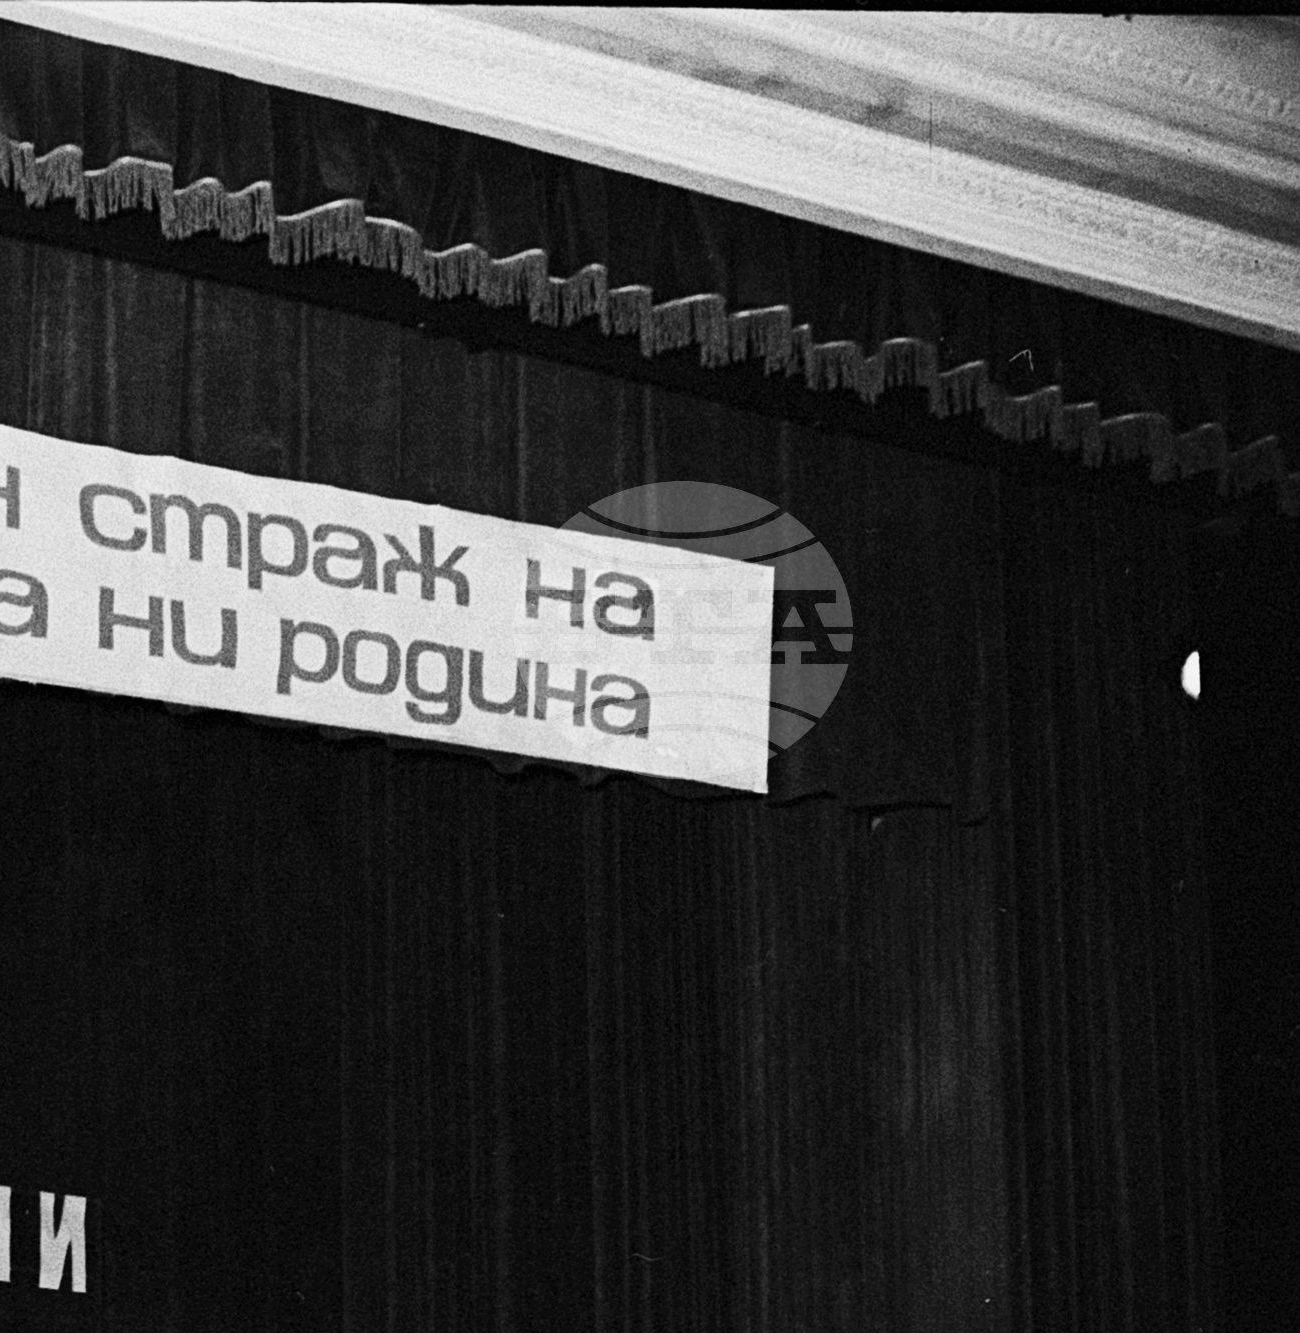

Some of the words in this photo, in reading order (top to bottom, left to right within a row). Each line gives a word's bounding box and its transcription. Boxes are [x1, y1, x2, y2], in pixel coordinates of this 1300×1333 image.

[77, 483, 472, 608] страж
[524, 557, 657, 642] на
[97, 585, 239, 671] ни
[275, 617, 652, 740] родина
